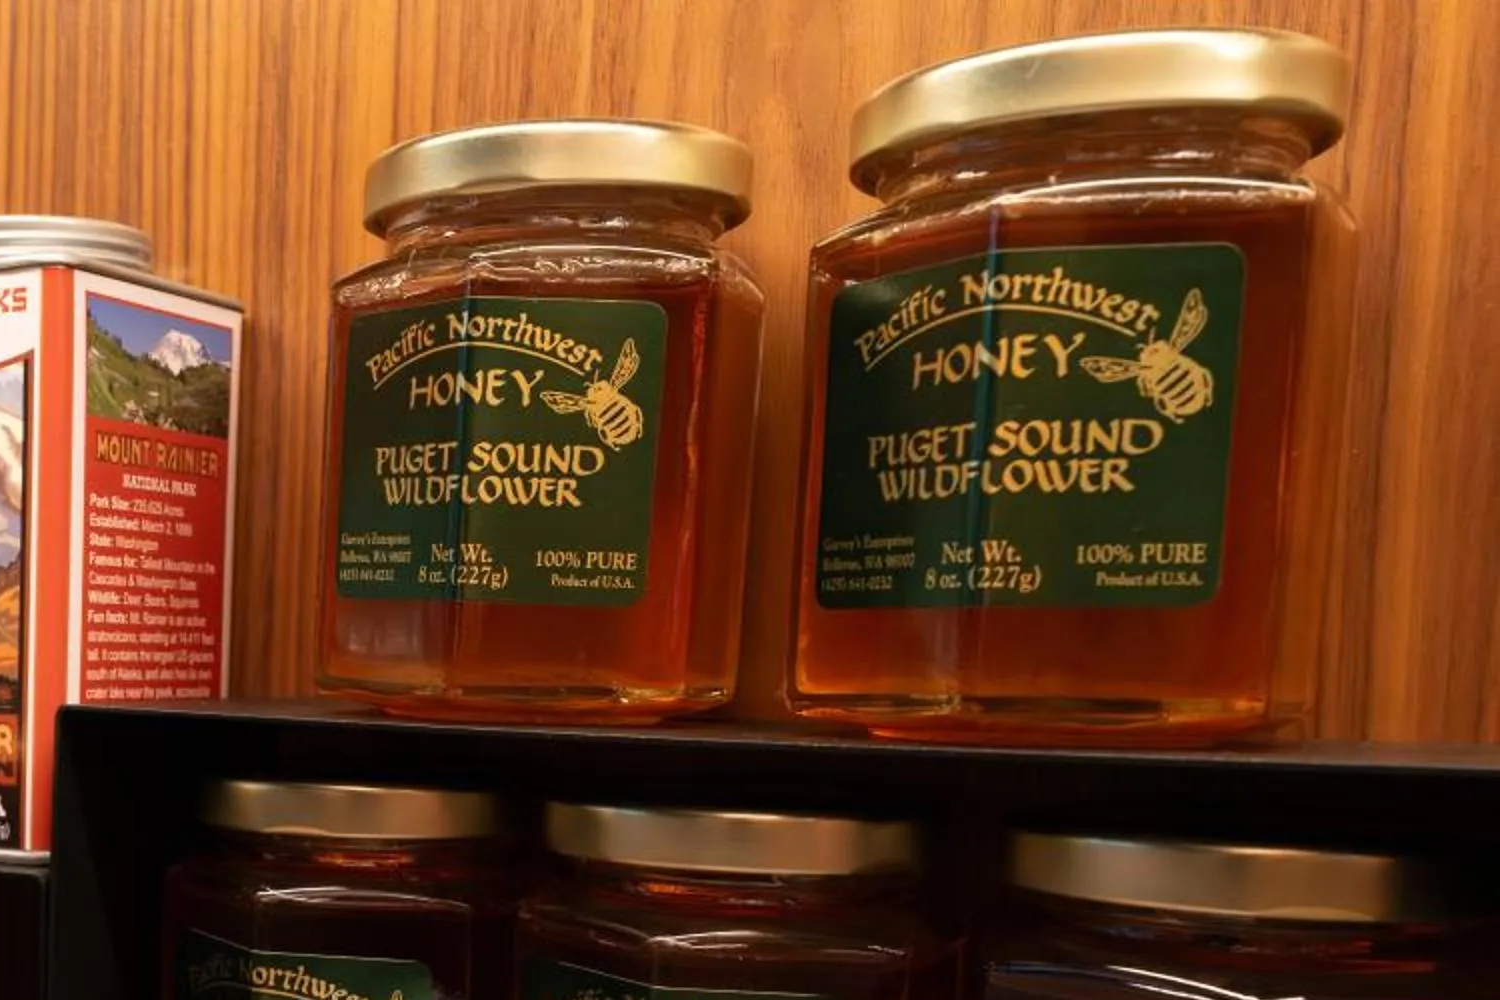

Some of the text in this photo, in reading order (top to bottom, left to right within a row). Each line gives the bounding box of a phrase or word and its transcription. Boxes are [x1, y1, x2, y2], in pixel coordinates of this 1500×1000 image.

[854, 266, 1160, 363] Pacific Northwest
[366, 310, 603, 383] Pacific Northwest
[912, 332, 1087, 391] HONEY
[410, 369, 544, 409] HONEY
[97, 433, 219, 478] MOUNT RAINIER
[867, 418, 1165, 469] PUGET SOUND
[376, 441, 606, 476] PUGET SOUND
[122, 474, 197, 497] NATIONAL PARK
[384, 475, 583, 507] WILDFLOWER
[878, 458, 1135, 502] WILDFLOWER
[89, 493, 110, 509] Park
[89, 550, 122, 567] Famous
[431, 543, 455, 563] Net
[460, 543, 493, 563] Wt.
[536, 550, 637, 570] 100% PURE
[941, 542, 973, 565] Net
[981, 539, 1022, 563] Wt.
[1076, 543, 1207, 566] 100% PURE
[418, 567, 427, 583] 8
[451, 566, 509, 589] (227g)
[551, 574, 636, 589] Product of U.S.A.
[925, 565, 1043, 593] 8 oz. (227g)
[1096, 570, 1204, 588] Product of U.S.A.
[88, 610, 104, 624] Fun
